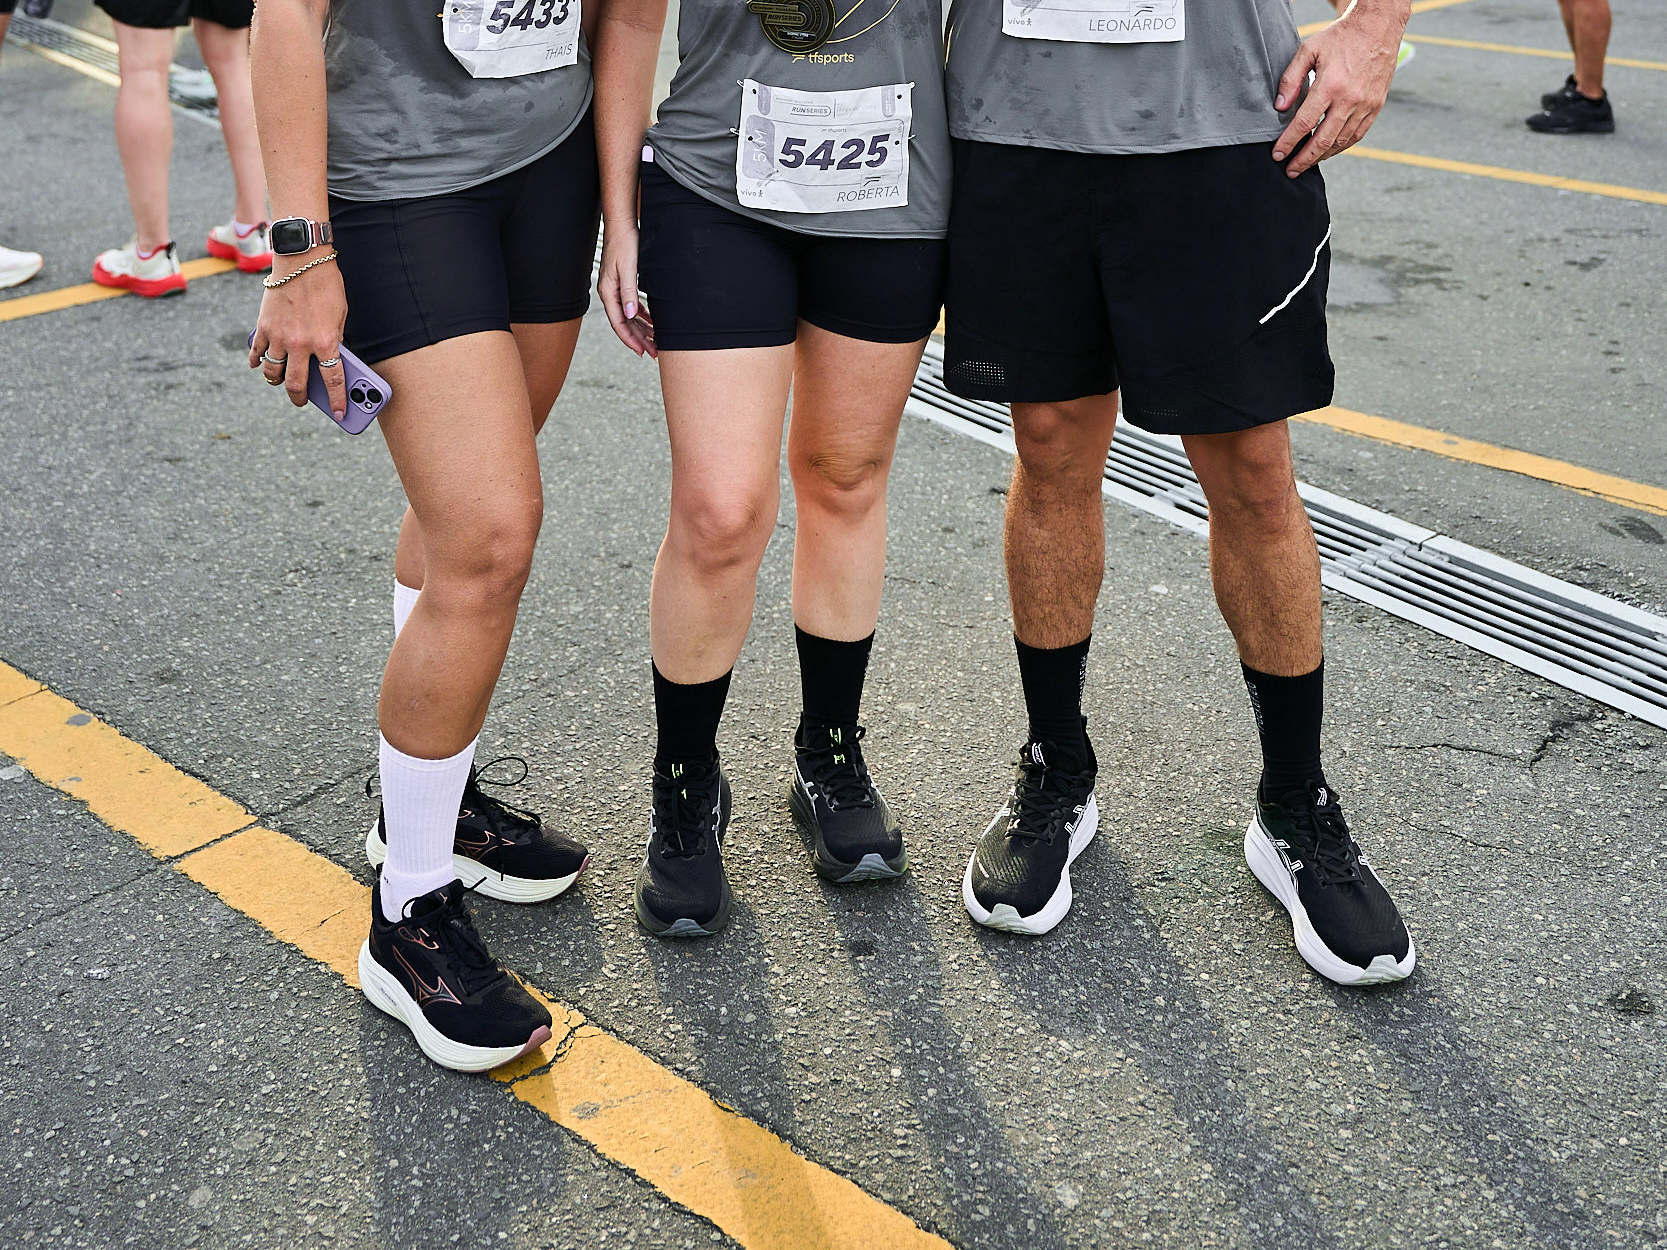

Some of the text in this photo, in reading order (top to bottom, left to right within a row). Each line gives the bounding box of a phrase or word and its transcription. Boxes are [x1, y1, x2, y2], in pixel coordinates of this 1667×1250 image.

[458, 0, 474, 34] 5KM
[1008, 18, 1026, 26] vivo
[1088, 17, 1177, 32] LEONARDO
[545, 43, 573, 60] THAIS
[808, 51, 855, 66] tfsports
[791, 106, 828, 114] RUNSERIES
[753, 129, 768, 163] 5KM
[778, 133, 891, 171] 5425
[836, 185, 900, 203] ROBERTA
